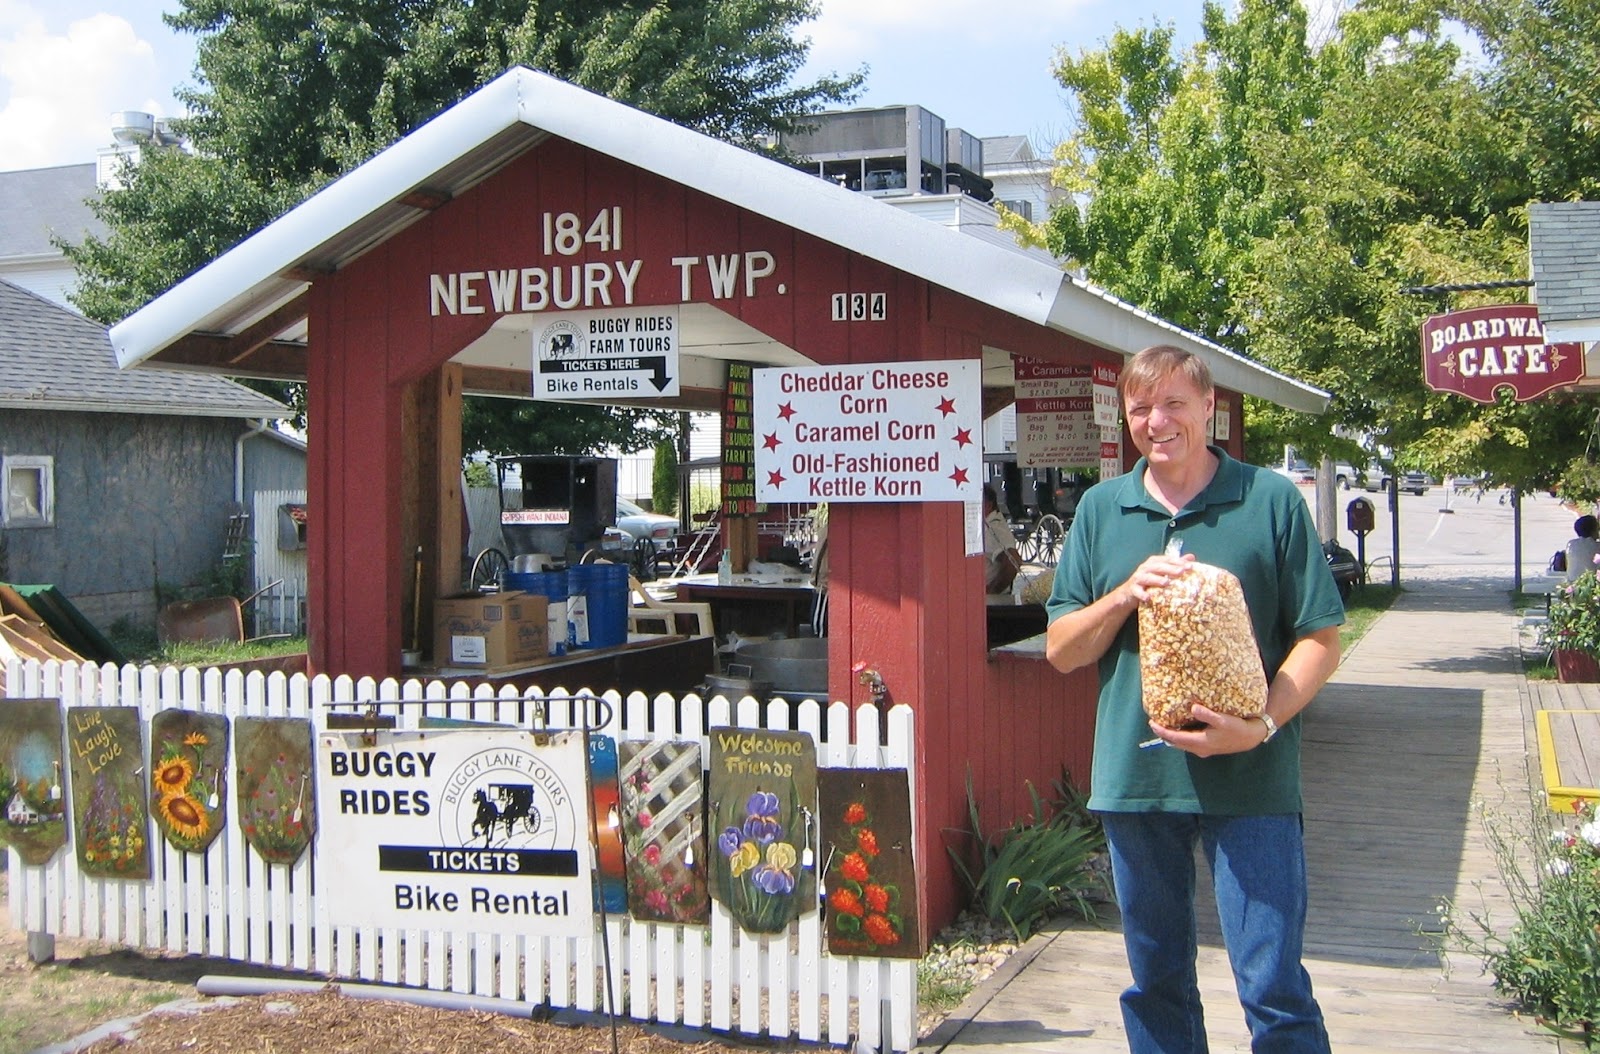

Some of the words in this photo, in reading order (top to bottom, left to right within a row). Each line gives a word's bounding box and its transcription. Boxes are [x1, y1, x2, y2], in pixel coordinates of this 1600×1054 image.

[543, 207, 622, 256] 1841
[430, 260, 643, 316] NEWBURY
[671, 251, 787, 301] TWP.
[833, 294, 886, 320] 134
[589, 319, 631, 334] BUGGY
[636, 316, 673, 332] RIDES
[1431, 318, 1543, 353] BOARDWA
[590, 338, 625, 354] FARM
[630, 337, 671, 352] TOURS
[562, 360, 607, 371] TICKETS
[610, 359, 640, 370] HERE
[1032, 366, 1072, 376] Caramel
[1458, 344, 1548, 377] CAFE
[547, 378, 578, 392] Bike
[584, 376, 638, 392] Rentals
[780, 371, 864, 393] Cheddar
[872, 370, 949, 391] Cheese
[840, 394, 887, 415] Corn
[1036, 401, 1066, 410] Kettle
[795, 421, 880, 443] Caramel
[887, 420, 936, 441] Corn
[726, 450, 744, 463] FARM
[792, 452, 940, 474] Old-Fashioned
[809, 477, 867, 497] Kettle
[874, 477, 922, 496] Korn
[74, 711, 102, 734] Live
[74, 722, 117, 758] Laugh
[718, 733, 803, 756] Welcome
[87, 743, 122, 774] Love
[330, 752, 436, 777] BUGGY
[724, 757, 792, 778] Friends
[445, 759, 482, 805] BUGGY
[485, 752, 523, 769] LANE
[527, 760, 567, 807] TOURS
[340, 789, 430, 816] RIDES
[428, 851, 520, 872] TICKETS
[395, 884, 458, 912] Bike
[471, 887, 568, 916] Rental
